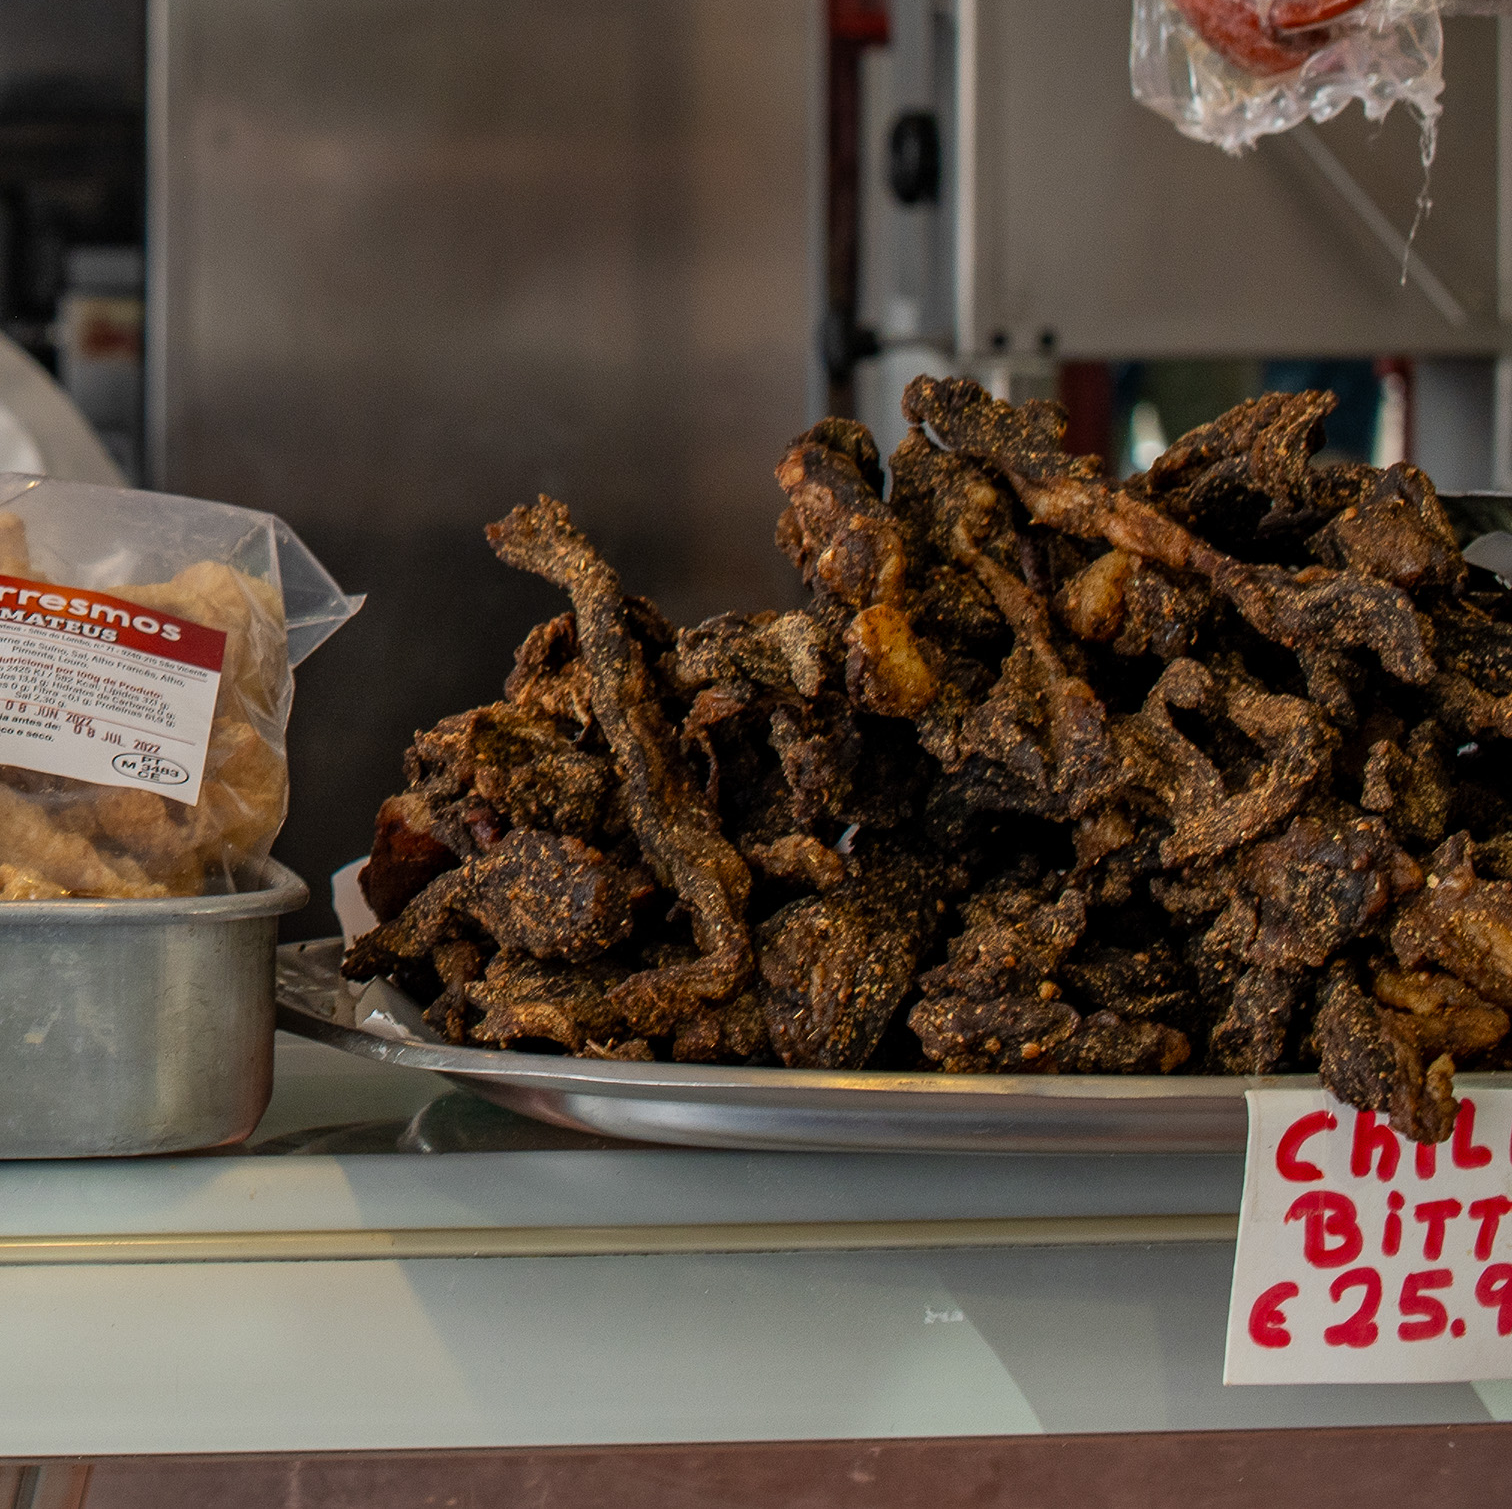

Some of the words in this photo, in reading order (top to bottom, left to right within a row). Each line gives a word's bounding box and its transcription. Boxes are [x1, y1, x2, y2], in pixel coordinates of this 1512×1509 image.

[12, 645, 56, 662] Pimenta,
[23, 640, 36, 648] de
[91, 654, 114, 667] Alho
[160, 673, 185, 688] Alho,
[55, 666, 73, 676] por
[77, 670, 101, 684] 100g
[103, 677, 116, 686] de
[119, 681, 163, 700] Produto:
[15, 690, 32, 701] Sal
[12, 716, 42, 727] antes
[45, 721, 61, 731] de:
[133, 739, 161, 754] 2022
[26, 730, 55, 742] seco.
[121, 760, 136, 769] M
[138, 771, 160, 781] CE
